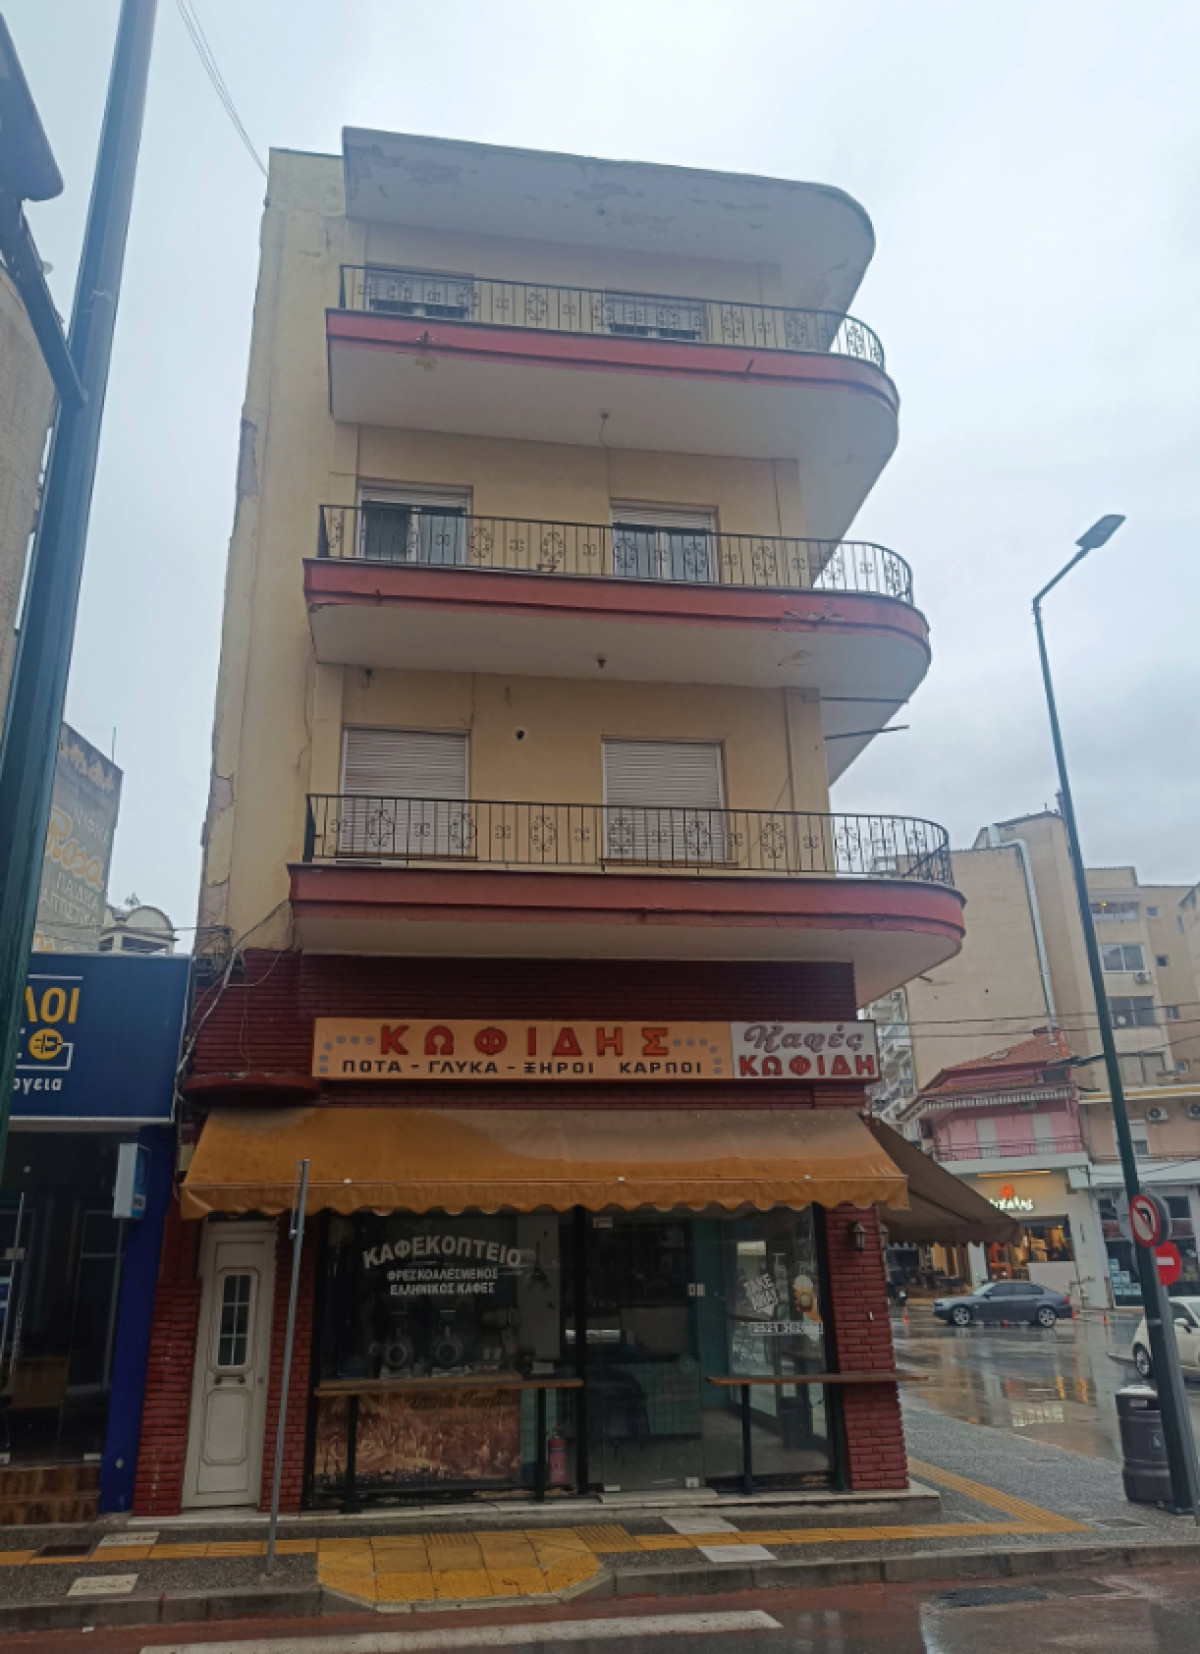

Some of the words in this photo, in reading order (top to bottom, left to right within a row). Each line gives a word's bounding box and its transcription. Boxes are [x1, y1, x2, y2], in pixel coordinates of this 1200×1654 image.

[380, 1024, 670, 1056] ΚΩΦΙΔΗΣ
[744, 1024, 864, 1053] Καφές
[342, 1060, 402, 1073] ΠΟΤΑ
[429, 1060, 498, 1074] ΓΛΥΚΑ
[523, 1061, 595, 1075] ΞΗΡΟΙ
[620, 1061, 702, 1075] ΚΑΡΠΟΙ
[739, 1054, 875, 1077] ΚΩΦΙΔΗ
[363, 1235, 522, 1269] ΚΑΦΕΚΟΠΤΕΙΟ
[457, 1282, 496, 1294] ΚΑΦΕΣ
